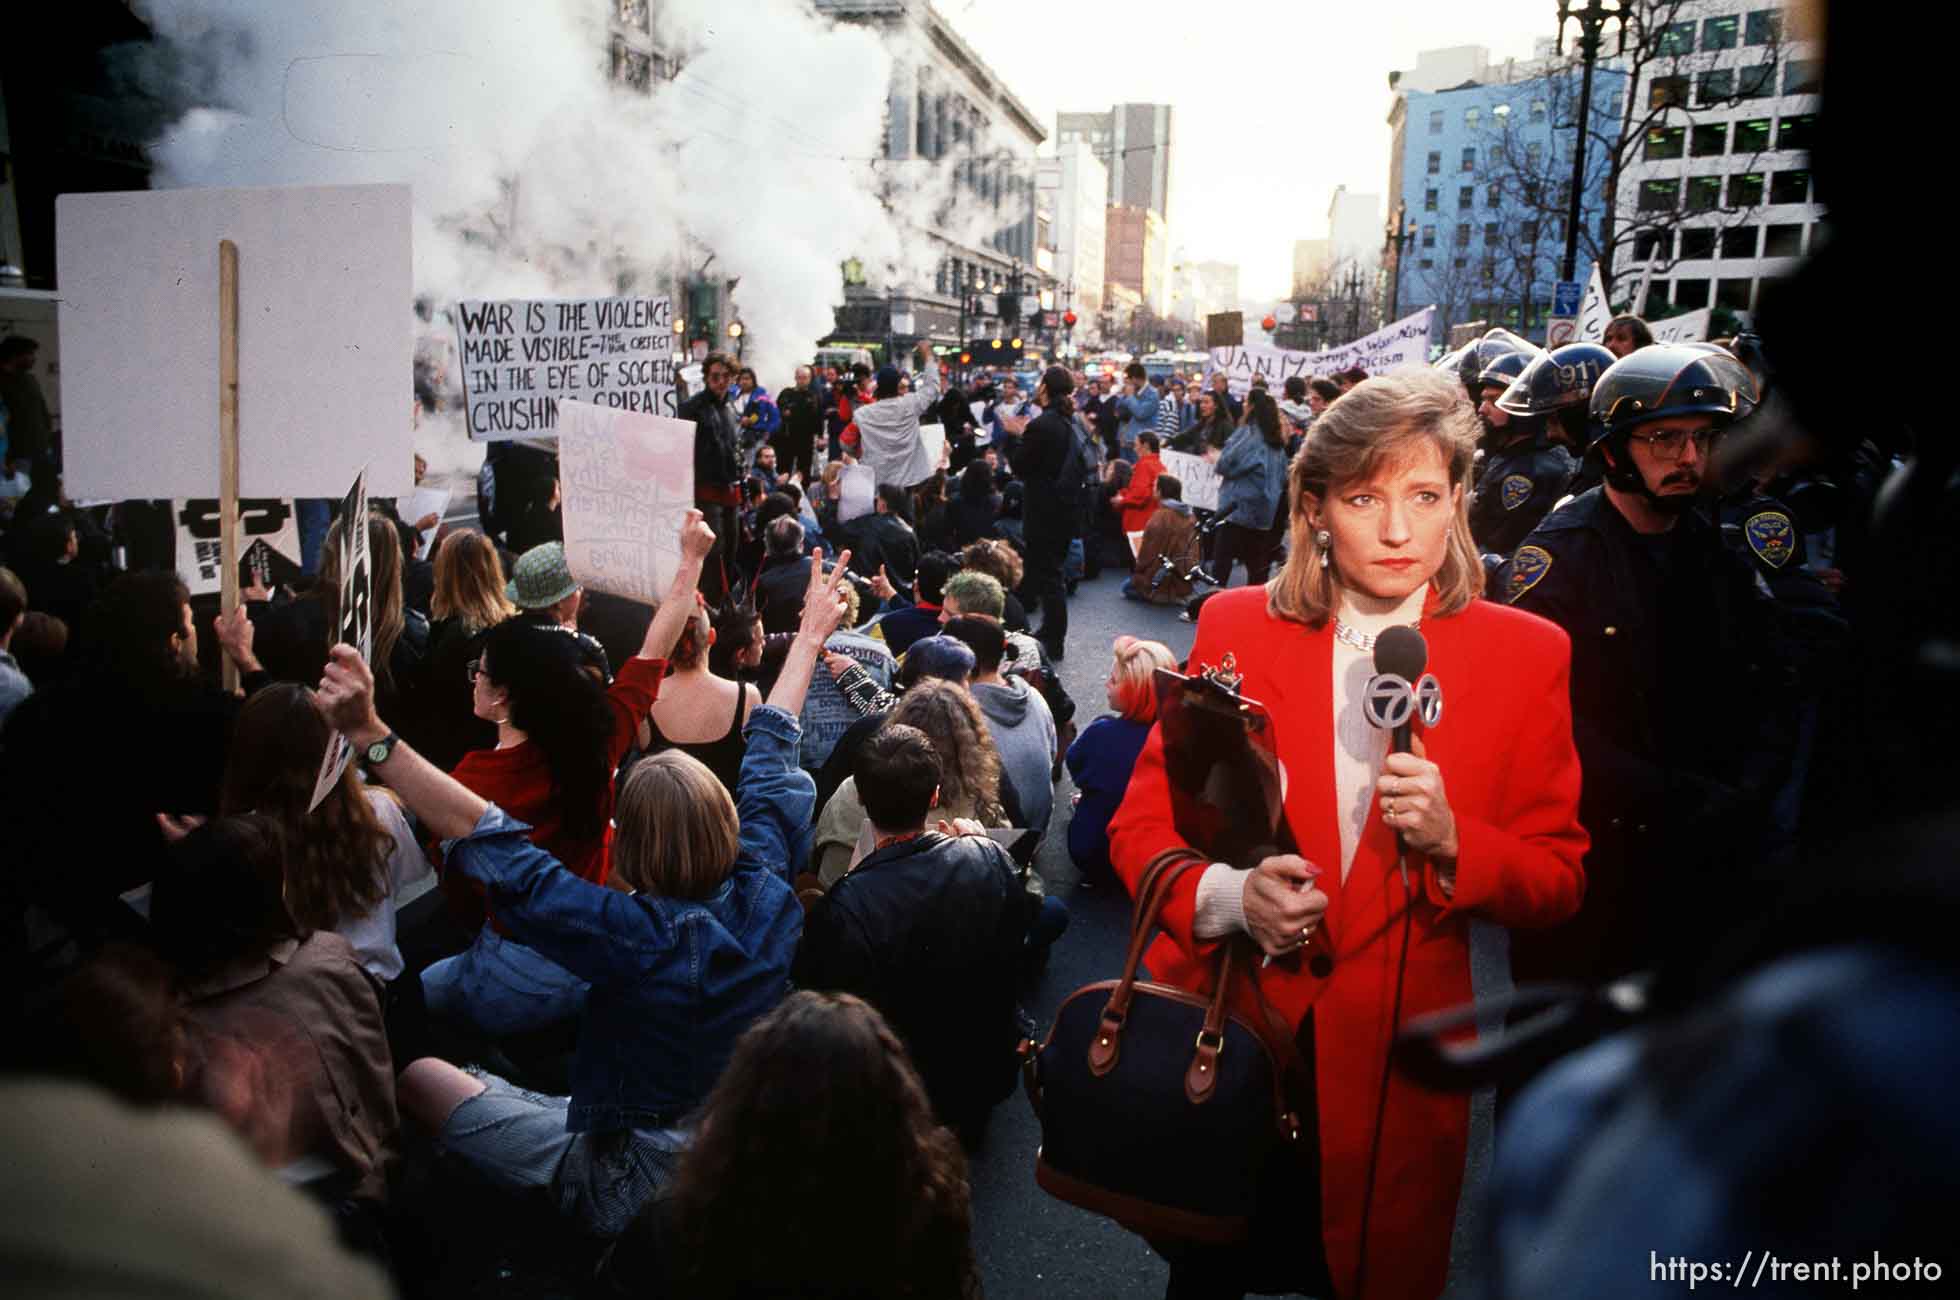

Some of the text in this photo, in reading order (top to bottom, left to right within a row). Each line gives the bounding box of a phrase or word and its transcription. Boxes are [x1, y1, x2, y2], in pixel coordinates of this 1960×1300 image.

[460, 300, 671, 335] WAR IS THE VIOLENCE
[464, 338, 515, 365] MADE
[471, 369, 498, 395] IN
[506, 367, 537, 391] THE
[547, 365, 581, 390] EYE
[587, 362, 612, 388] OF
[472, 396, 578, 433] CRUSHIN
[1369, 683, 1440, 724] 7 7
